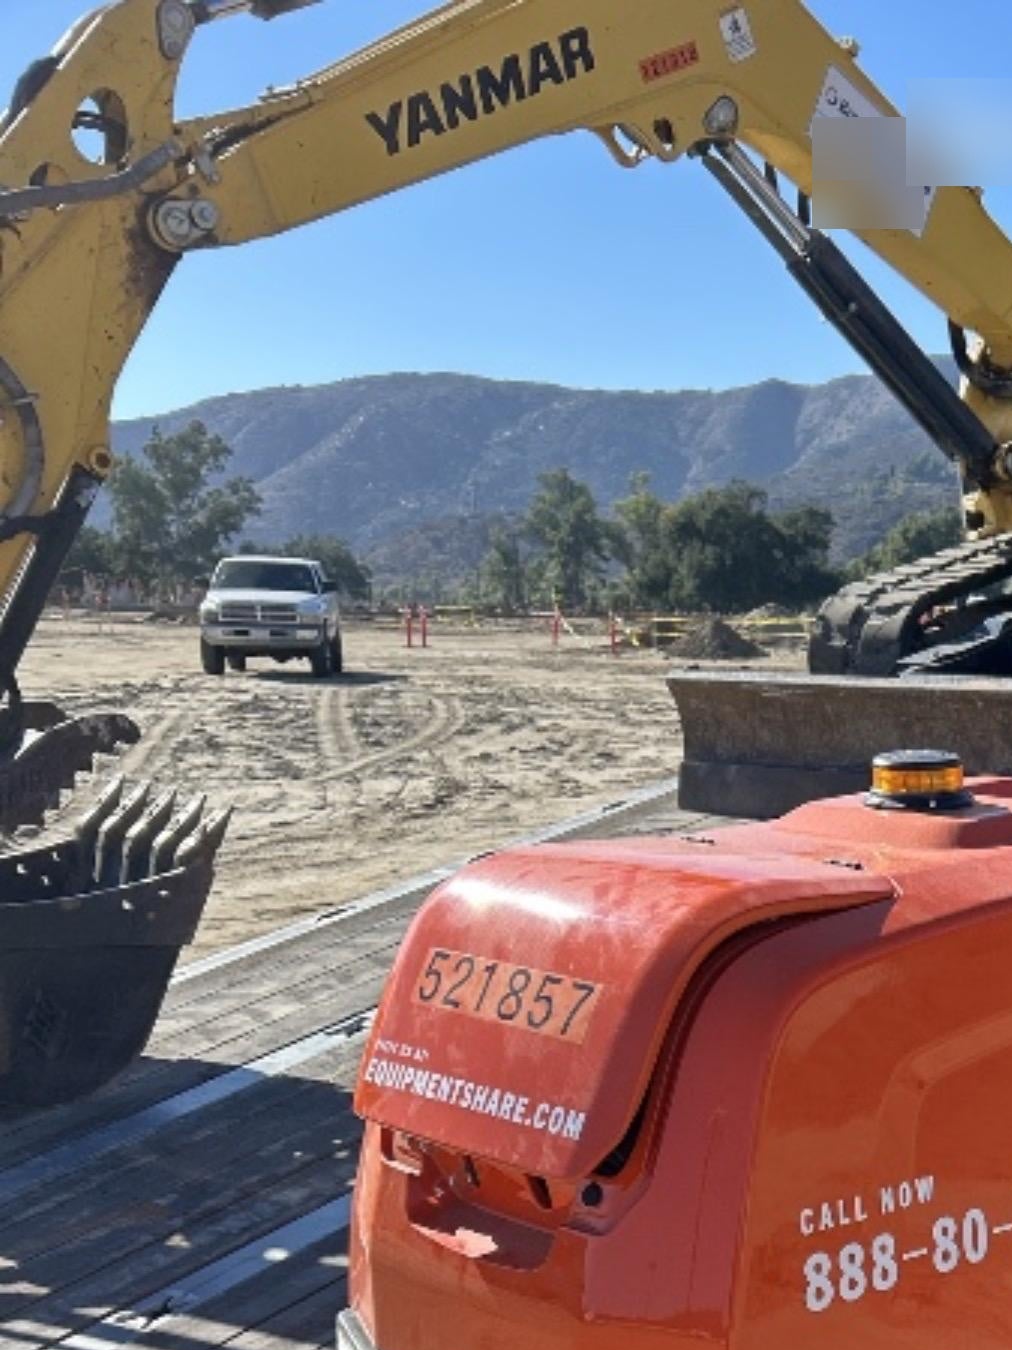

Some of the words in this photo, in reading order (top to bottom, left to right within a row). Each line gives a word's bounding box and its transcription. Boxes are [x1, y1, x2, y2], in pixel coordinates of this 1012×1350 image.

[365, 26, 595, 156] YANMAR
[418, 951, 595, 1036] 521857
[364, 1058, 587, 1140] EQUIPMENTSHARE.COM
[800, 1196, 867, 1236] CALL
[880, 1175, 935, 1215] NOW
